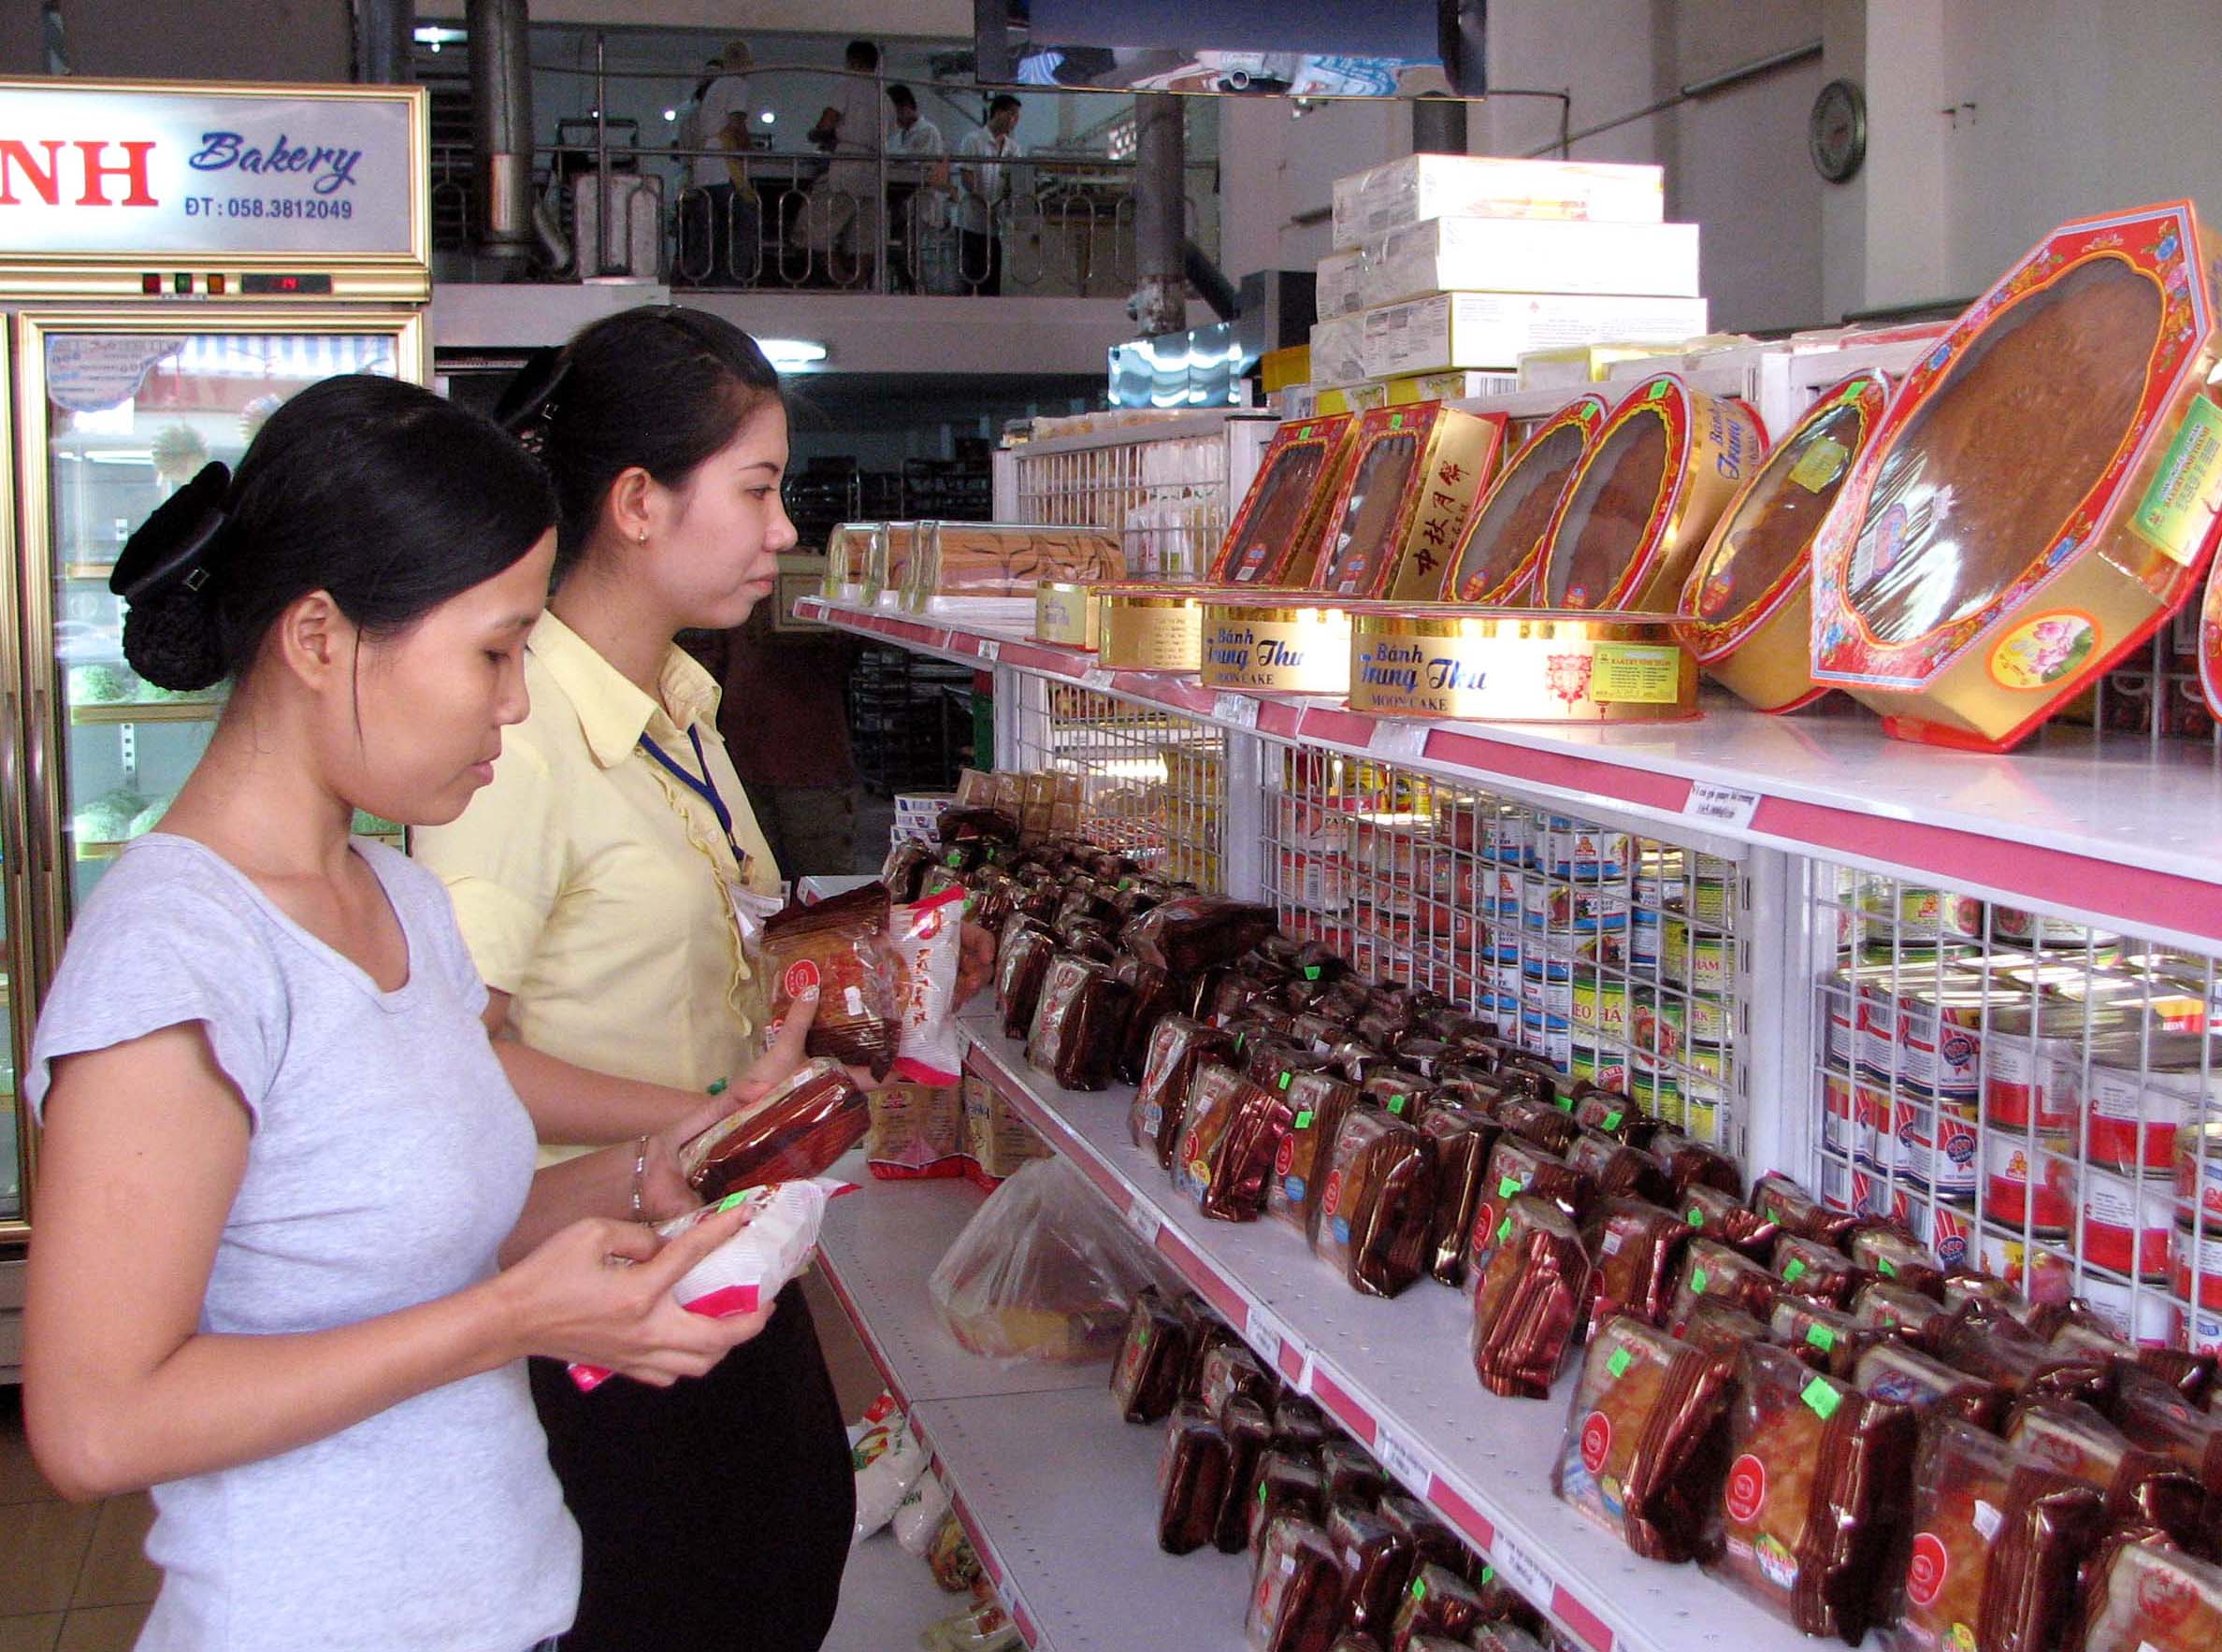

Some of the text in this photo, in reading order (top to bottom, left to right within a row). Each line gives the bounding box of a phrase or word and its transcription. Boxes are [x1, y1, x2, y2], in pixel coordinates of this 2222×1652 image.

[189, 132, 362, 194] Bakery
[228, 198, 353, 220] 058.3812049
[1219, 627, 1254, 645] Bánh
[1256, 639, 1306, 668] Thu
[1377, 643, 1423, 664] Bánh
[1426, 657, 1488, 690] Thu
